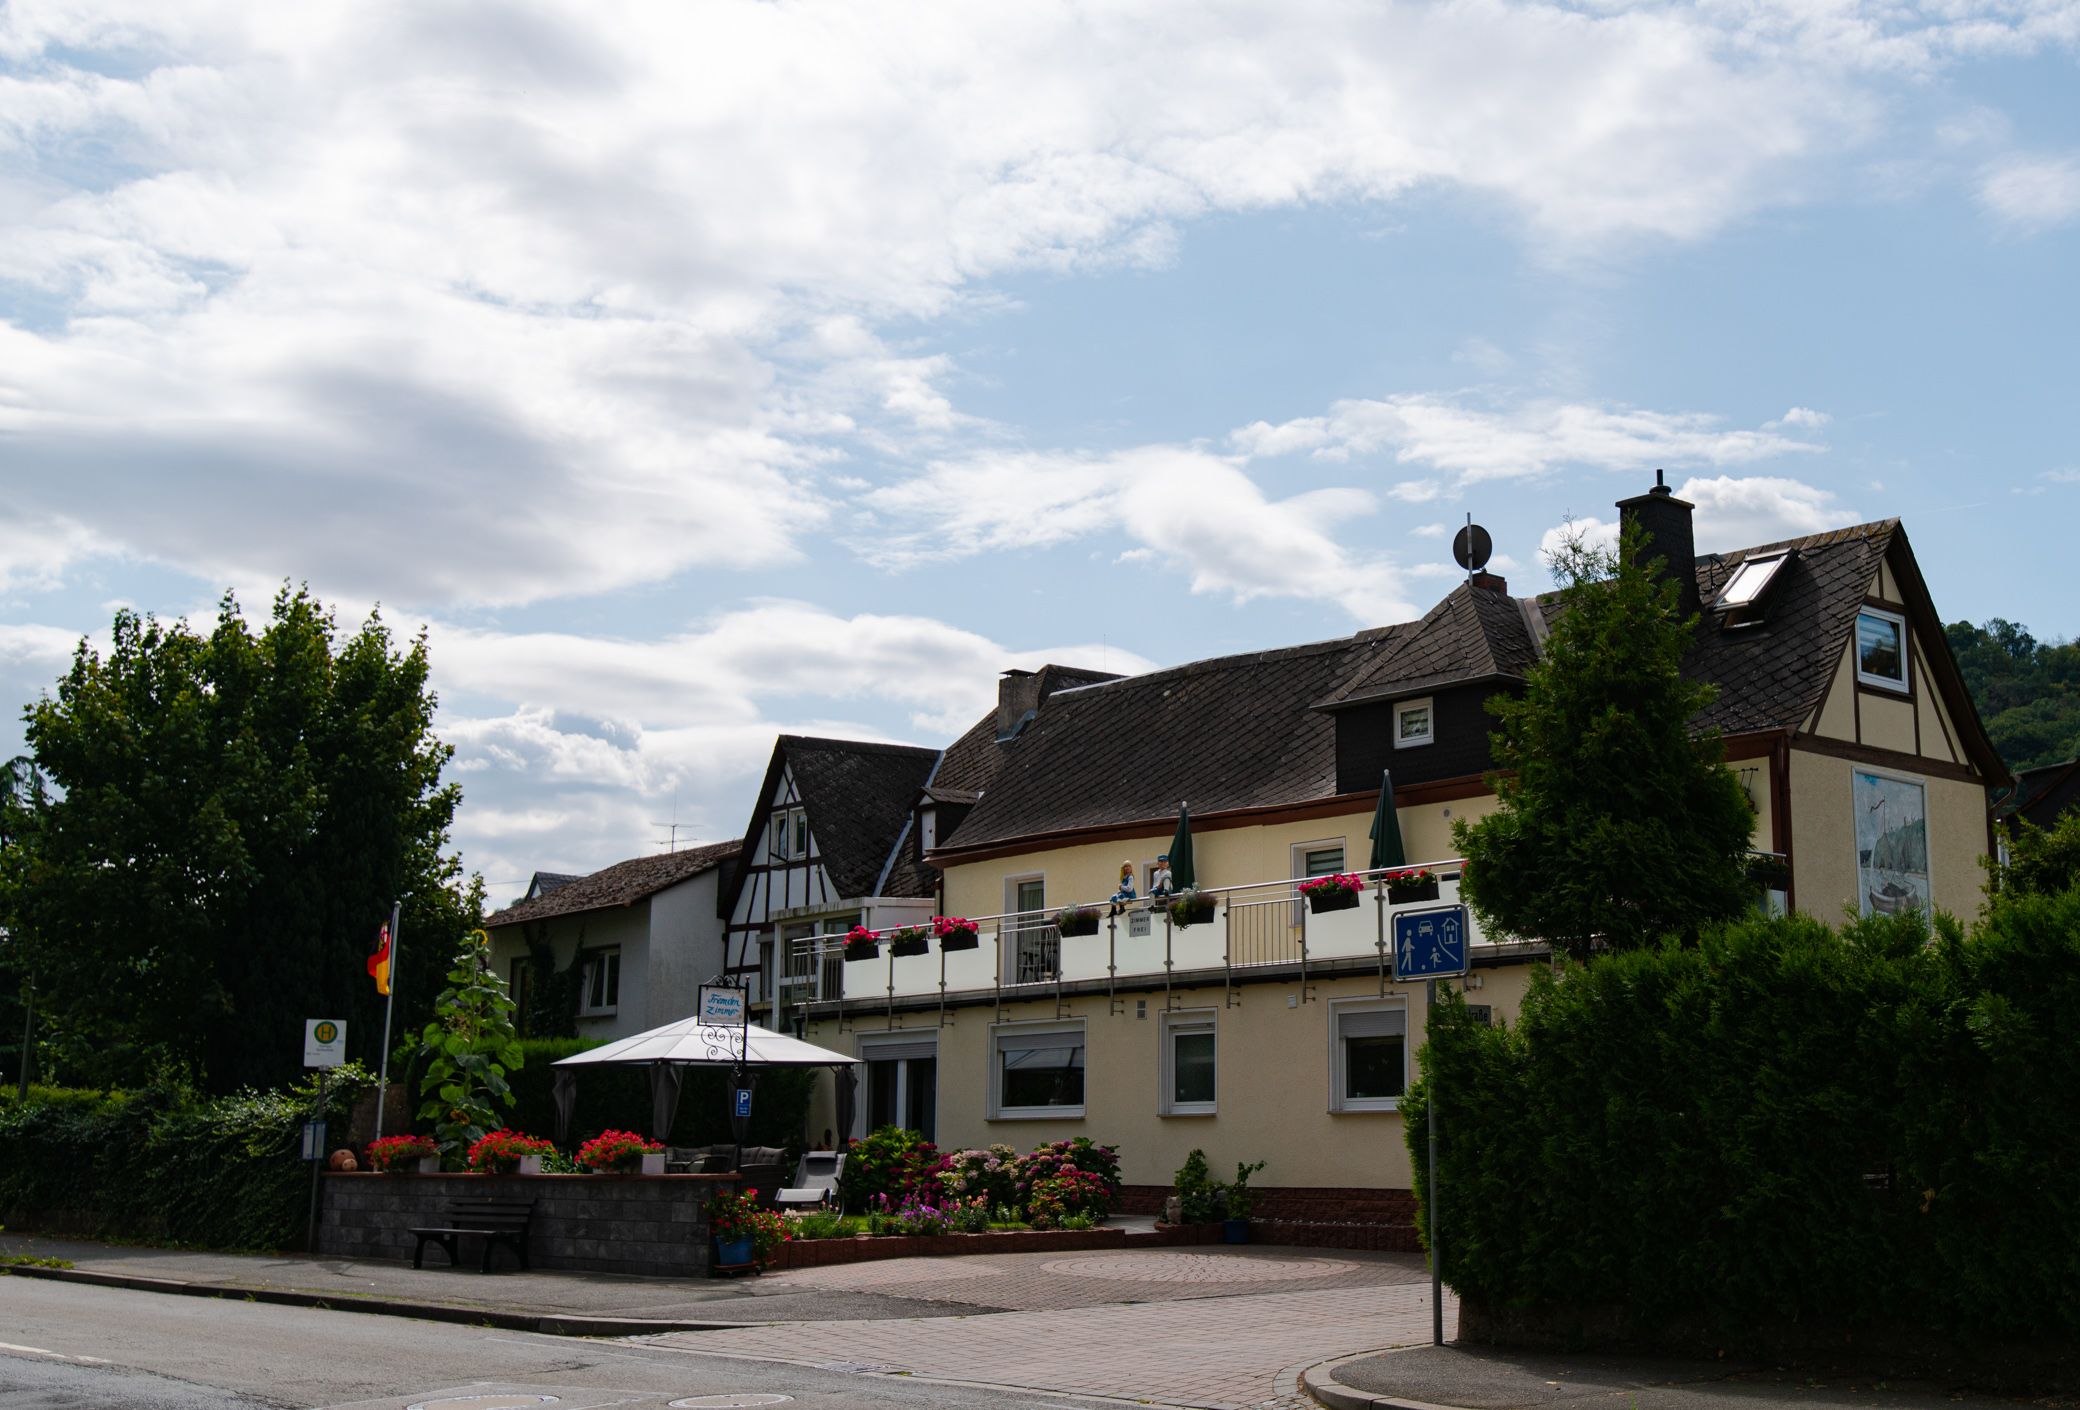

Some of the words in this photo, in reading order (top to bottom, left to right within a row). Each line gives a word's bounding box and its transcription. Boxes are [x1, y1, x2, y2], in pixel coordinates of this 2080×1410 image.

[706, 1006, 740, 1016] Zimmer
[321, 1026, 332, 1039] H
[740, 1092, 749, 1103] P
